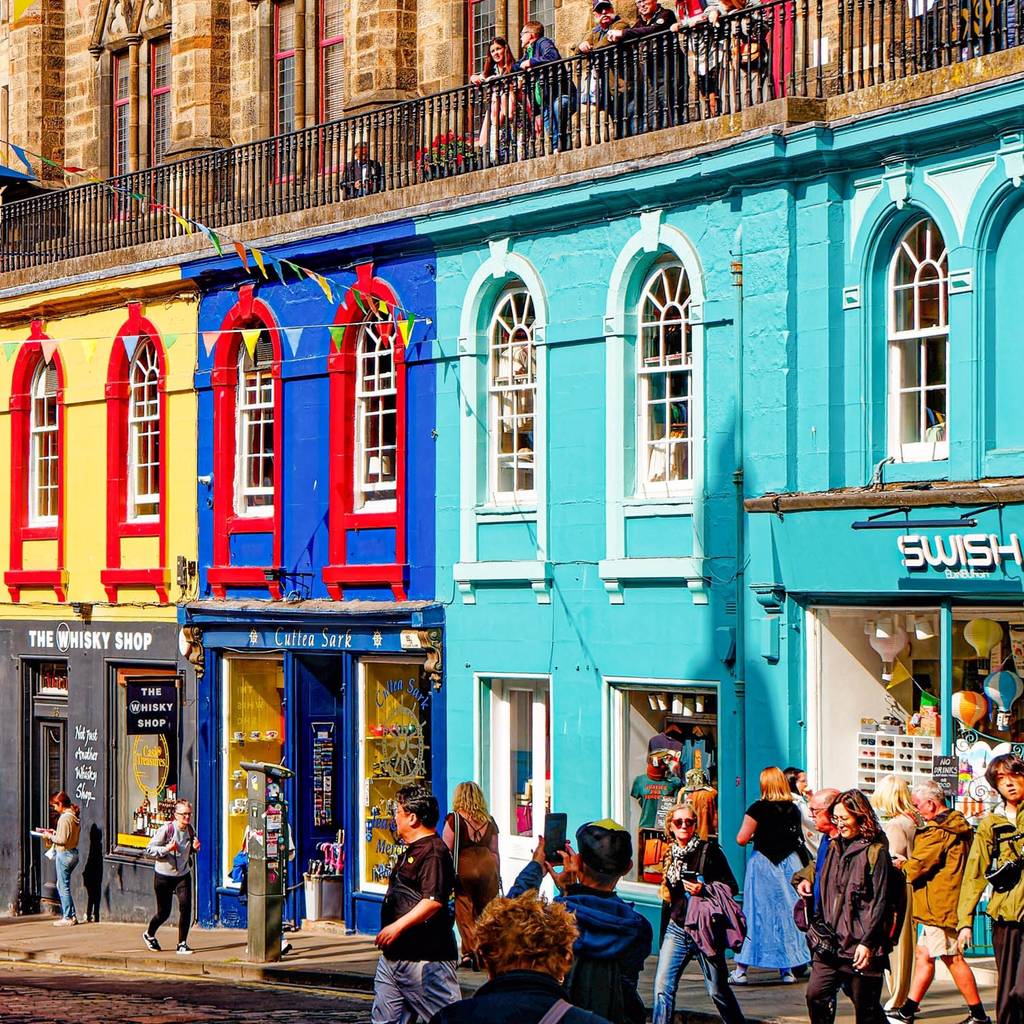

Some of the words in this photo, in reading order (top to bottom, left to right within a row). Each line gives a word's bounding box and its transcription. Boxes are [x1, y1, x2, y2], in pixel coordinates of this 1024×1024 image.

[897, 533, 1022, 567] SWISH
[29, 630, 54, 648] THE
[57, 629, 111, 650] WHISKY
[114, 631, 153, 651] SHOP
[275, 627, 315, 647] Cuttea
[321, 627, 352, 648] Sark
[140, 687, 163, 697] THE
[407, 678, 429, 710] Sark
[129, 702, 174, 713] WHISKY
[137, 718, 167, 728] SHOP
[75, 747, 98, 761] Another
[75, 765, 97, 787] Whisky
[933, 766, 958, 775] DRINKS
